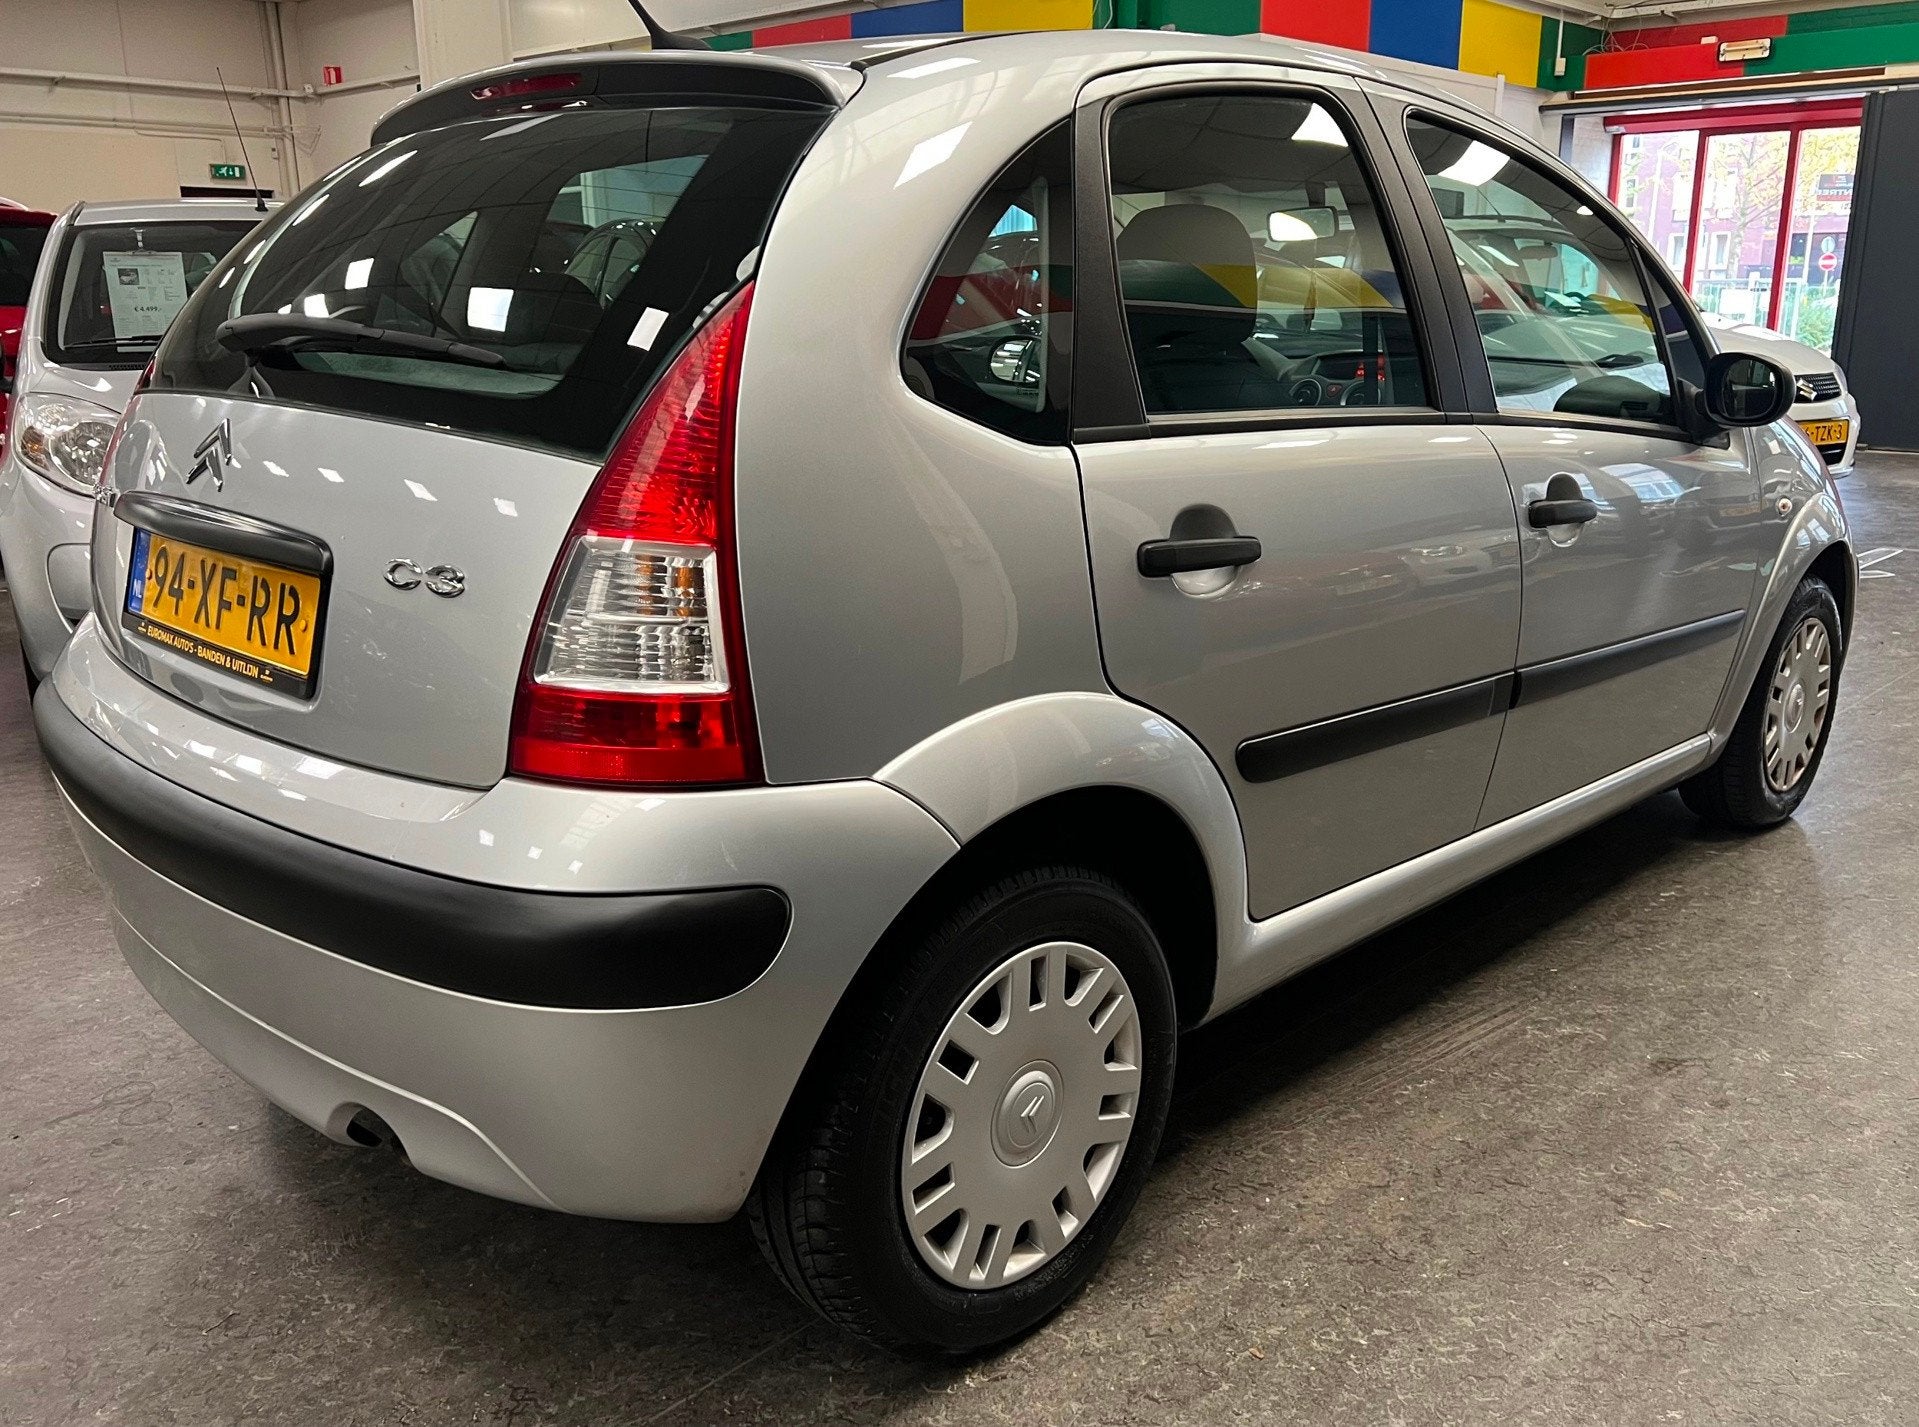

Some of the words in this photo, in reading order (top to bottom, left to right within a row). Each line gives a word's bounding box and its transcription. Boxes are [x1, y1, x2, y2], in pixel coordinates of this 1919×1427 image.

[133, 578, 143, 599] NL
[383, 558, 465, 598] C3
[152, 545, 301, 656] 94-XF-RR
[147, 625, 174, 646] EUROMAX
[197, 645, 226, 666] BANDEN
[225, 656, 231, 668] &
